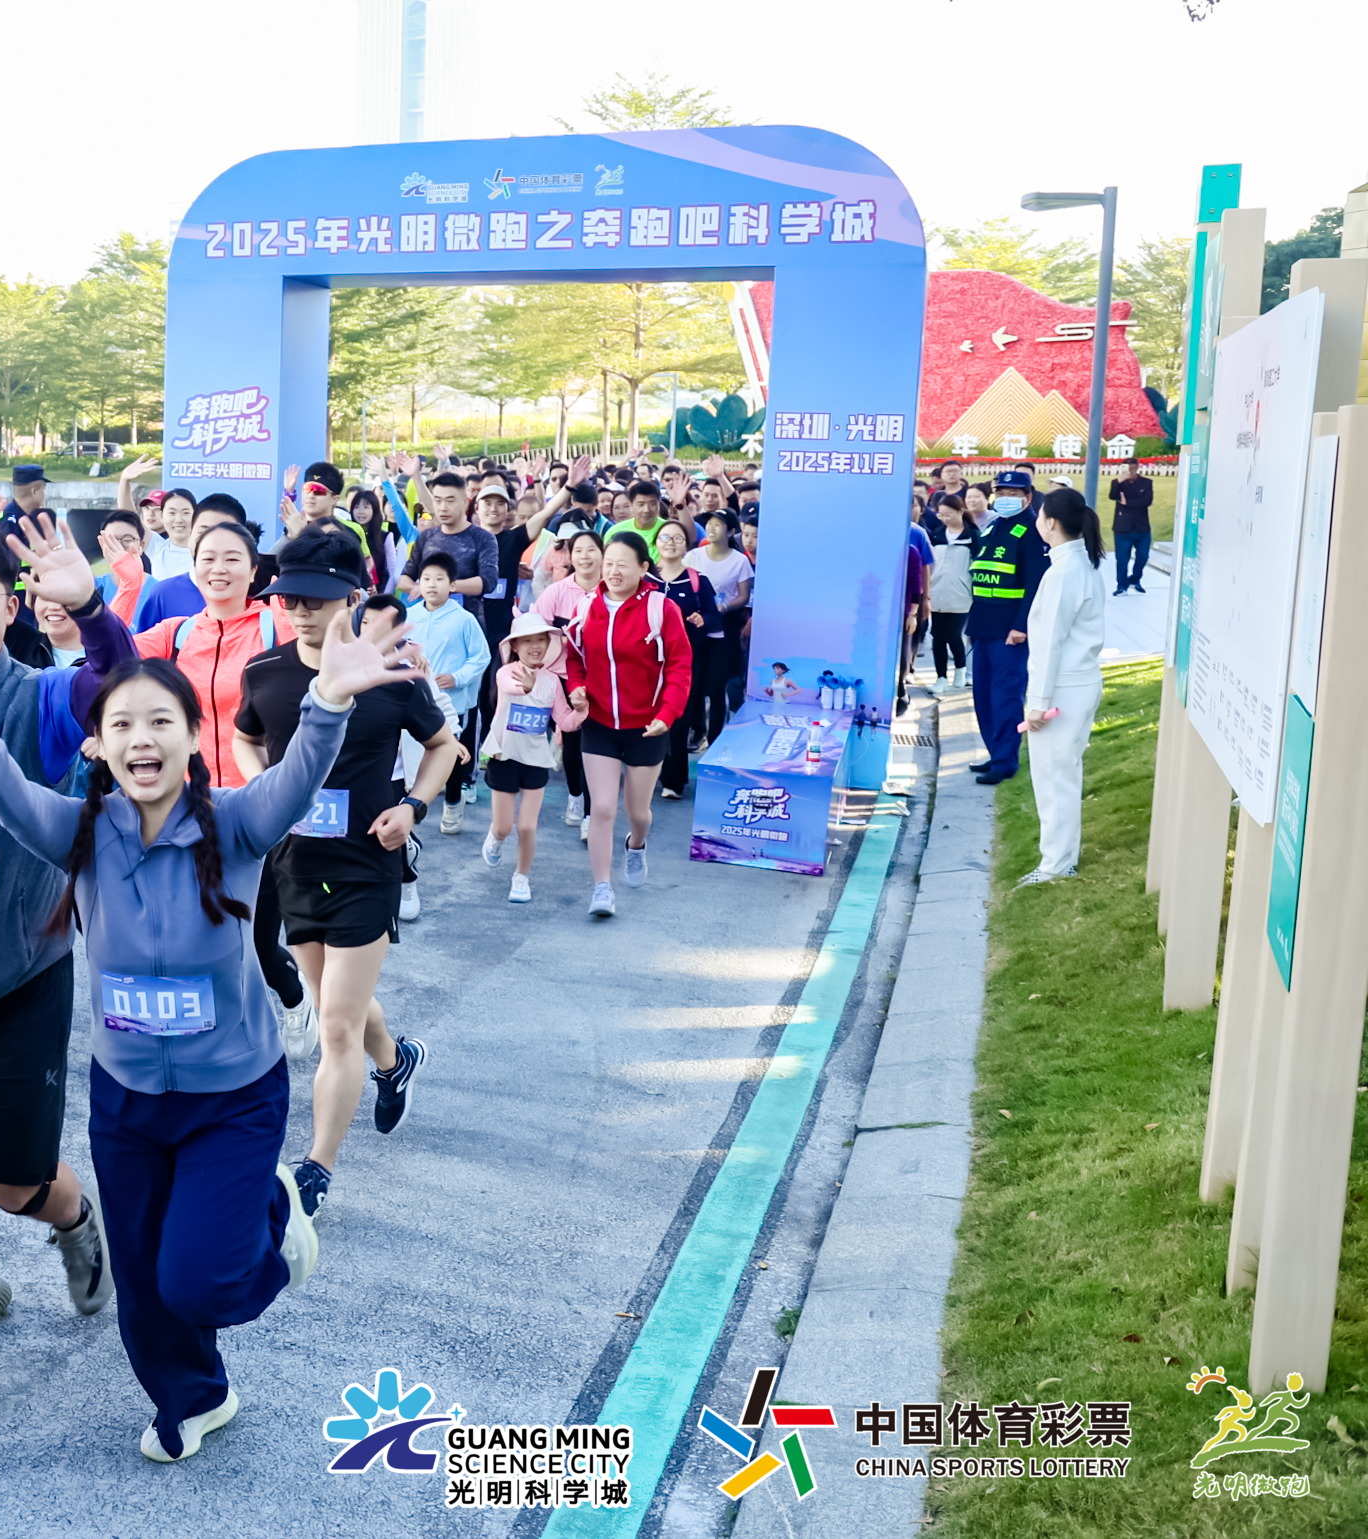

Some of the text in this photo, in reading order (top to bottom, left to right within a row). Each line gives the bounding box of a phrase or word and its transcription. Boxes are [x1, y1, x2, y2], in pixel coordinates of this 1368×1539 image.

[205, 201, 876, 258] 2025年光明微跑之奔跑吧科学城
[178, 388, 268, 425] 奔跑吧
[172, 414, 269, 456] 科学城
[951, 433, 1137, 459] 牢记使命
[170, 462, 271, 479] 2025年光明微跑
[778, 451, 894, 475] 2025年11月
[972, 573, 1000, 584] AOAN
[512, 711, 548, 728] 0225
[304, 803, 338, 824] 21
[112, 989, 201, 1019] 0103
